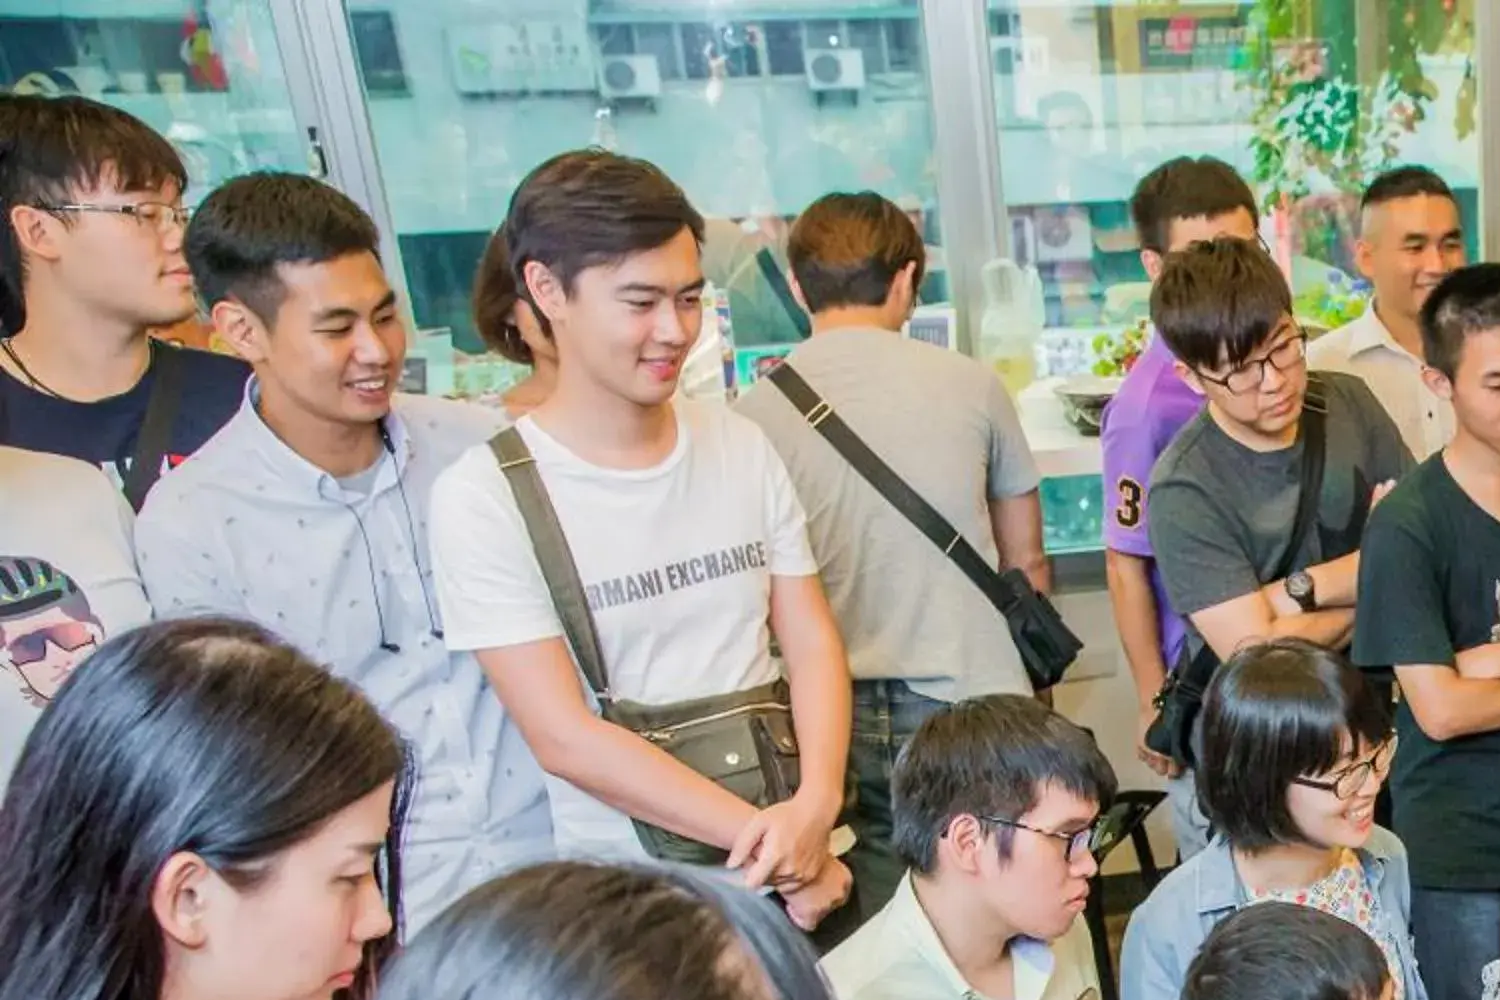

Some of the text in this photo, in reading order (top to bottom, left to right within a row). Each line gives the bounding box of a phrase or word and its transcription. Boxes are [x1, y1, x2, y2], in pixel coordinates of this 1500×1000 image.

[1116, 478, 1141, 528] 3
[585, 541, 767, 612] RMANI EXCHANGE
